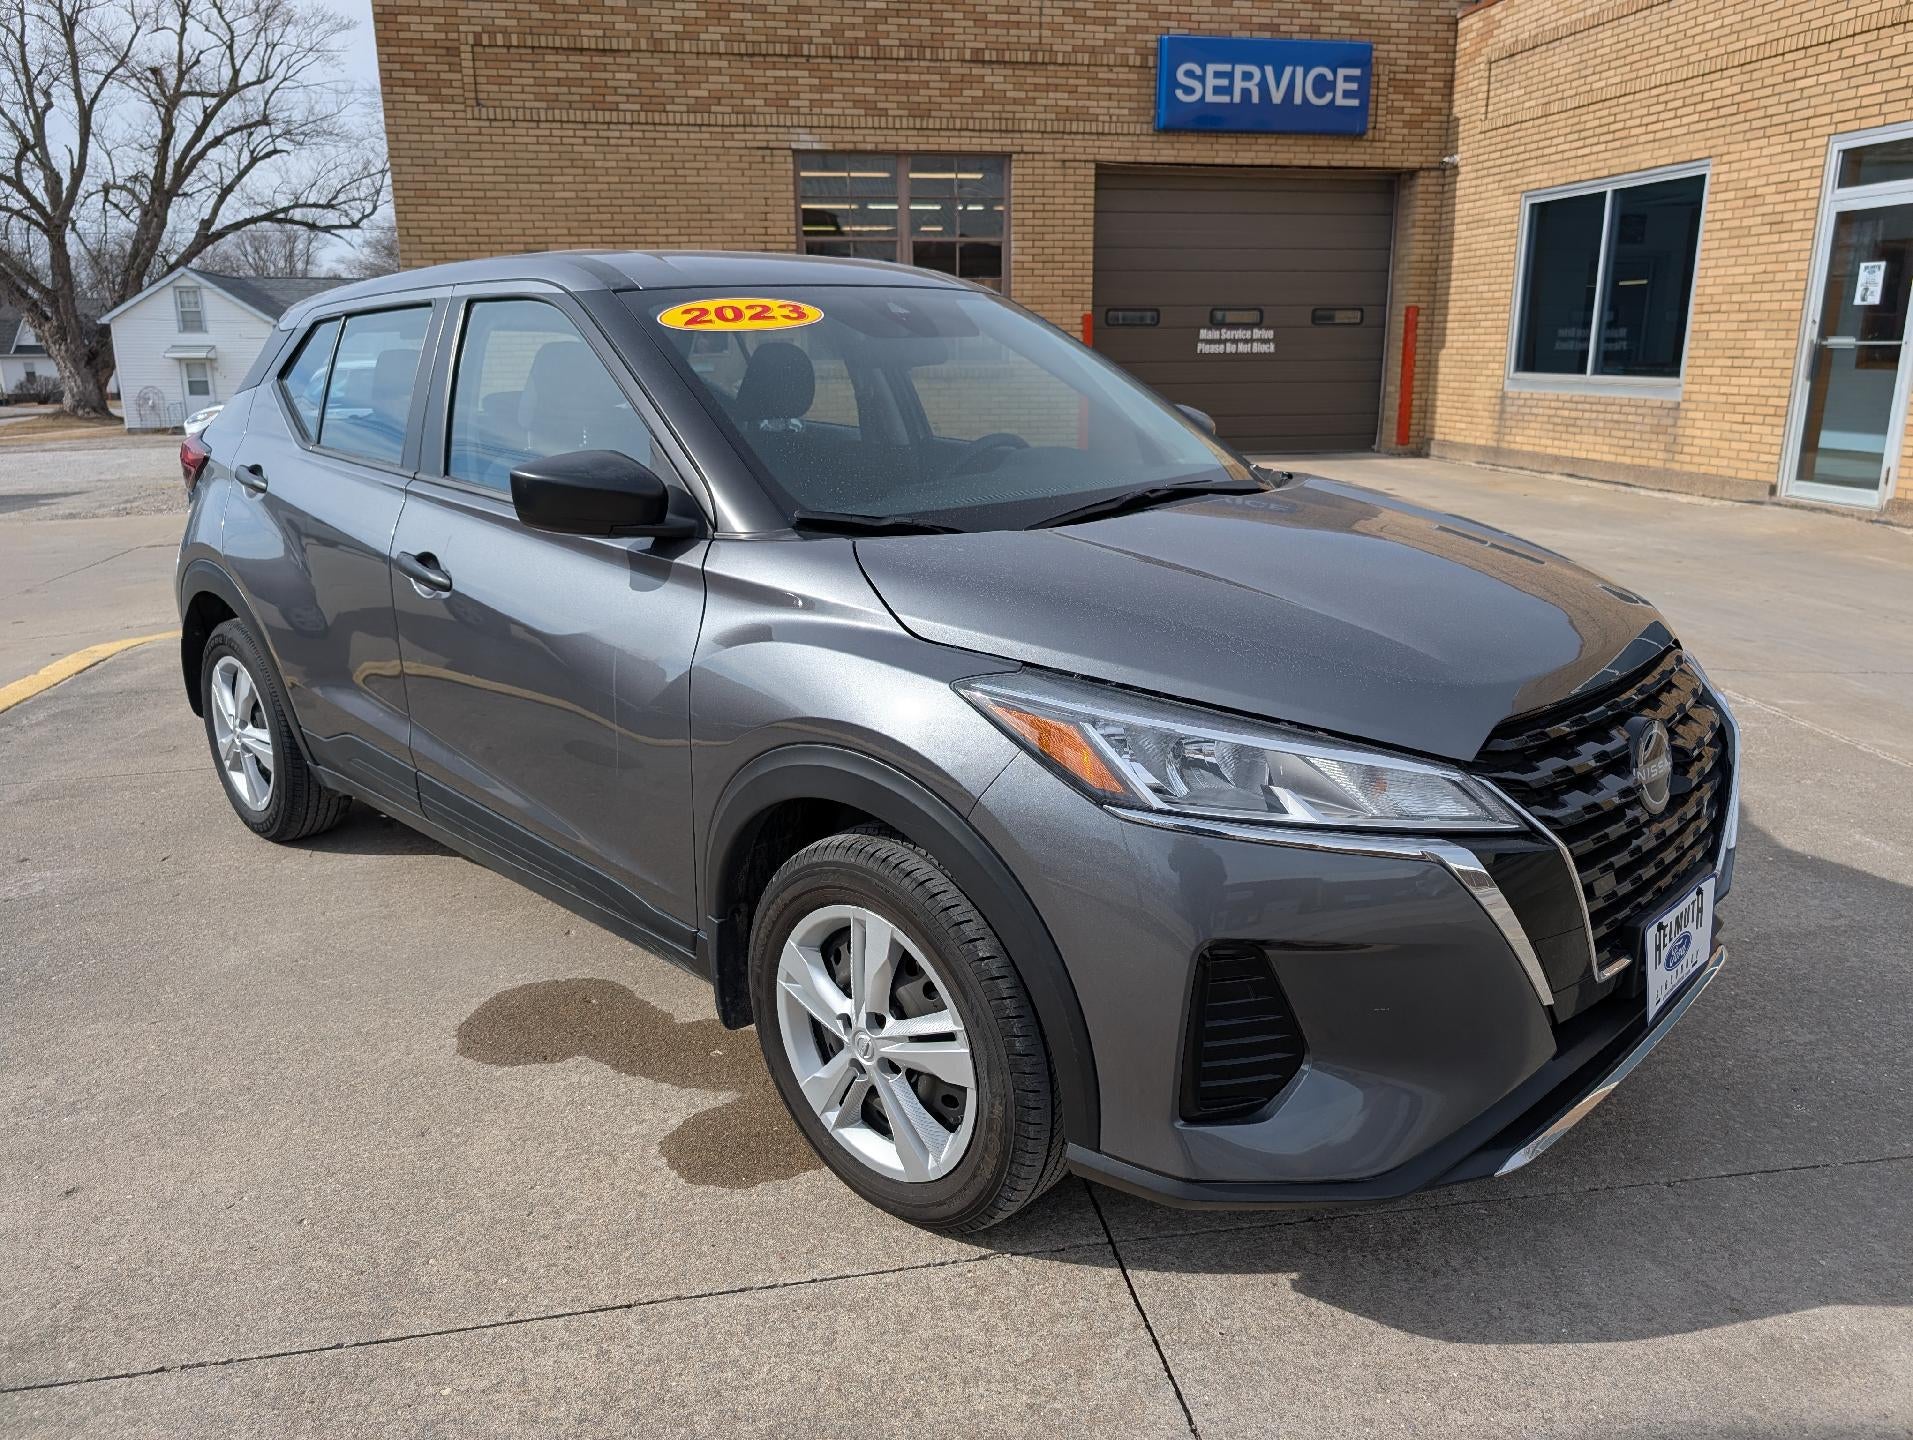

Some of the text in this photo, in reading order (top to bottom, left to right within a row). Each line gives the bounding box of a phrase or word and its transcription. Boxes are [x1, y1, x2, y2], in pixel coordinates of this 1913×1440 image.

[1175, 63, 1361, 107] SERVICE
[681, 304, 809, 327] 2023
[1200, 328, 1274, 340] Main Service Drive
[1197, 342, 1275, 354] Please Do Not Block
[1654, 887, 1703, 970] HELMUTH
